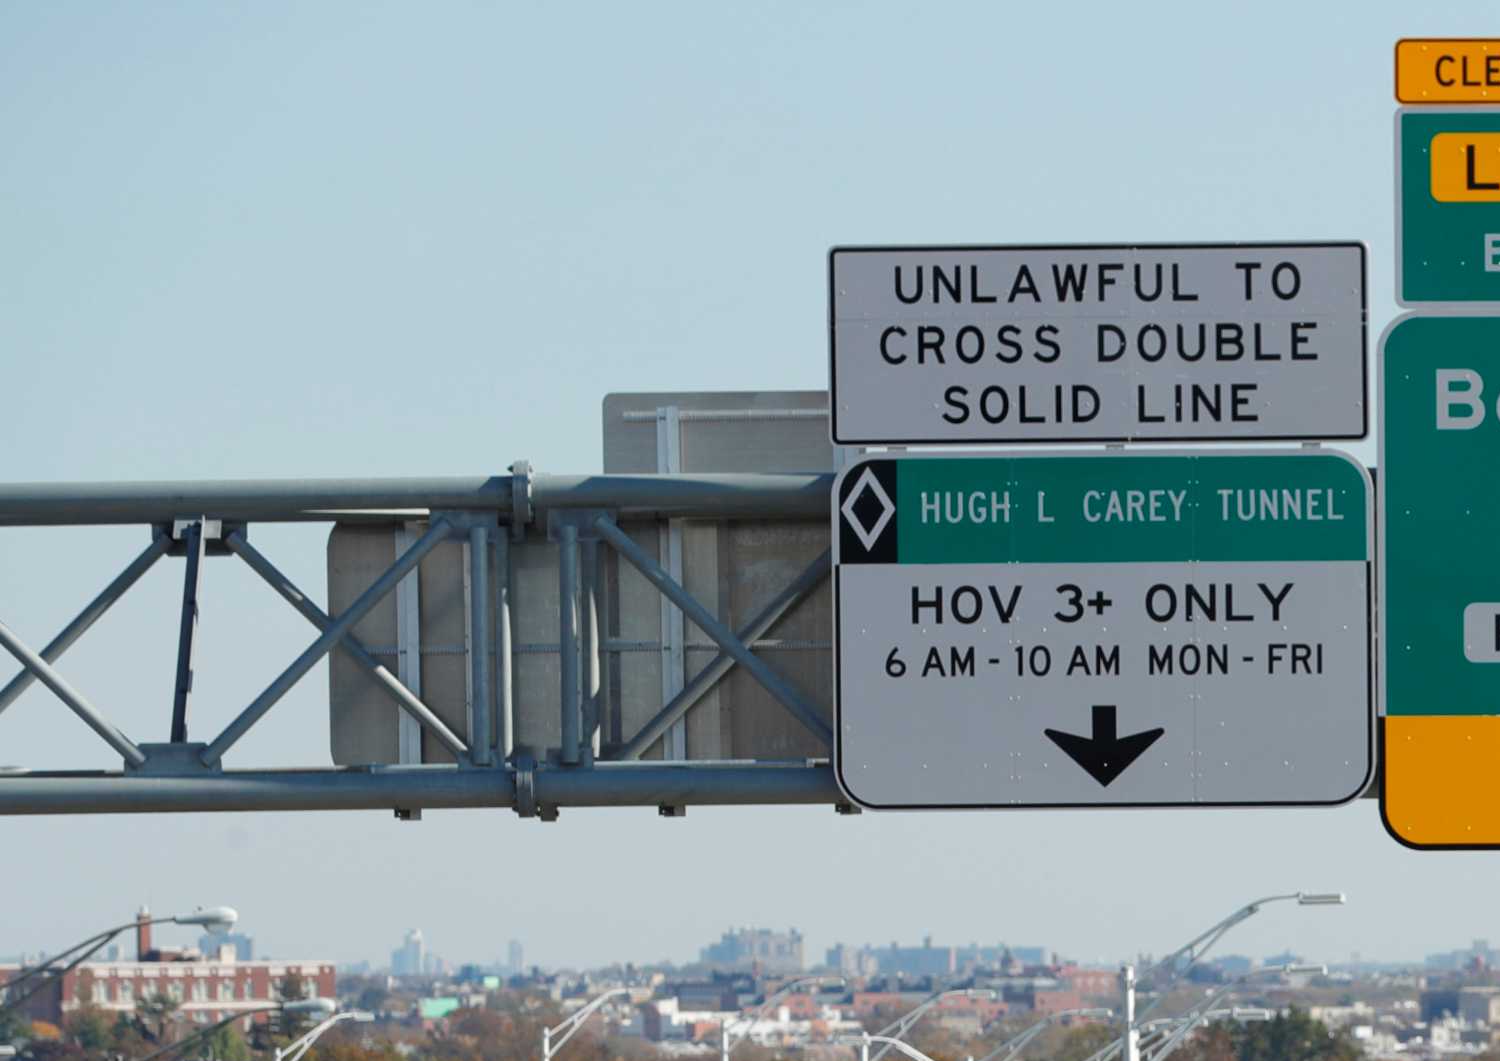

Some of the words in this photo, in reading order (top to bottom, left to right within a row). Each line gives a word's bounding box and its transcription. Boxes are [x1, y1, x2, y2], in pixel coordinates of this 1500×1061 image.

[895, 264, 1198, 304] UNLAWFUL
[1236, 262, 1300, 300] TO
[880, 325, 1060, 364] CROSS
[1098, 323, 1317, 362] DOUBLE
[943, 385, 1100, 424] SOLID
[1139, 384, 1258, 422] LINE
[921, 492, 1010, 523] HUGH
[1038, 491, 1054, 521] L
[1084, 490, 1186, 522] CAREY
[1218, 489, 1343, 520] TUNNEL
[912, 586, 1021, 624] HOV
[1055, 584, 1112, 622] 3+
[1146, 584, 1293, 622] ONLY
[886, 648, 906, 677] 6
[1067, 646, 1119, 675] AM
